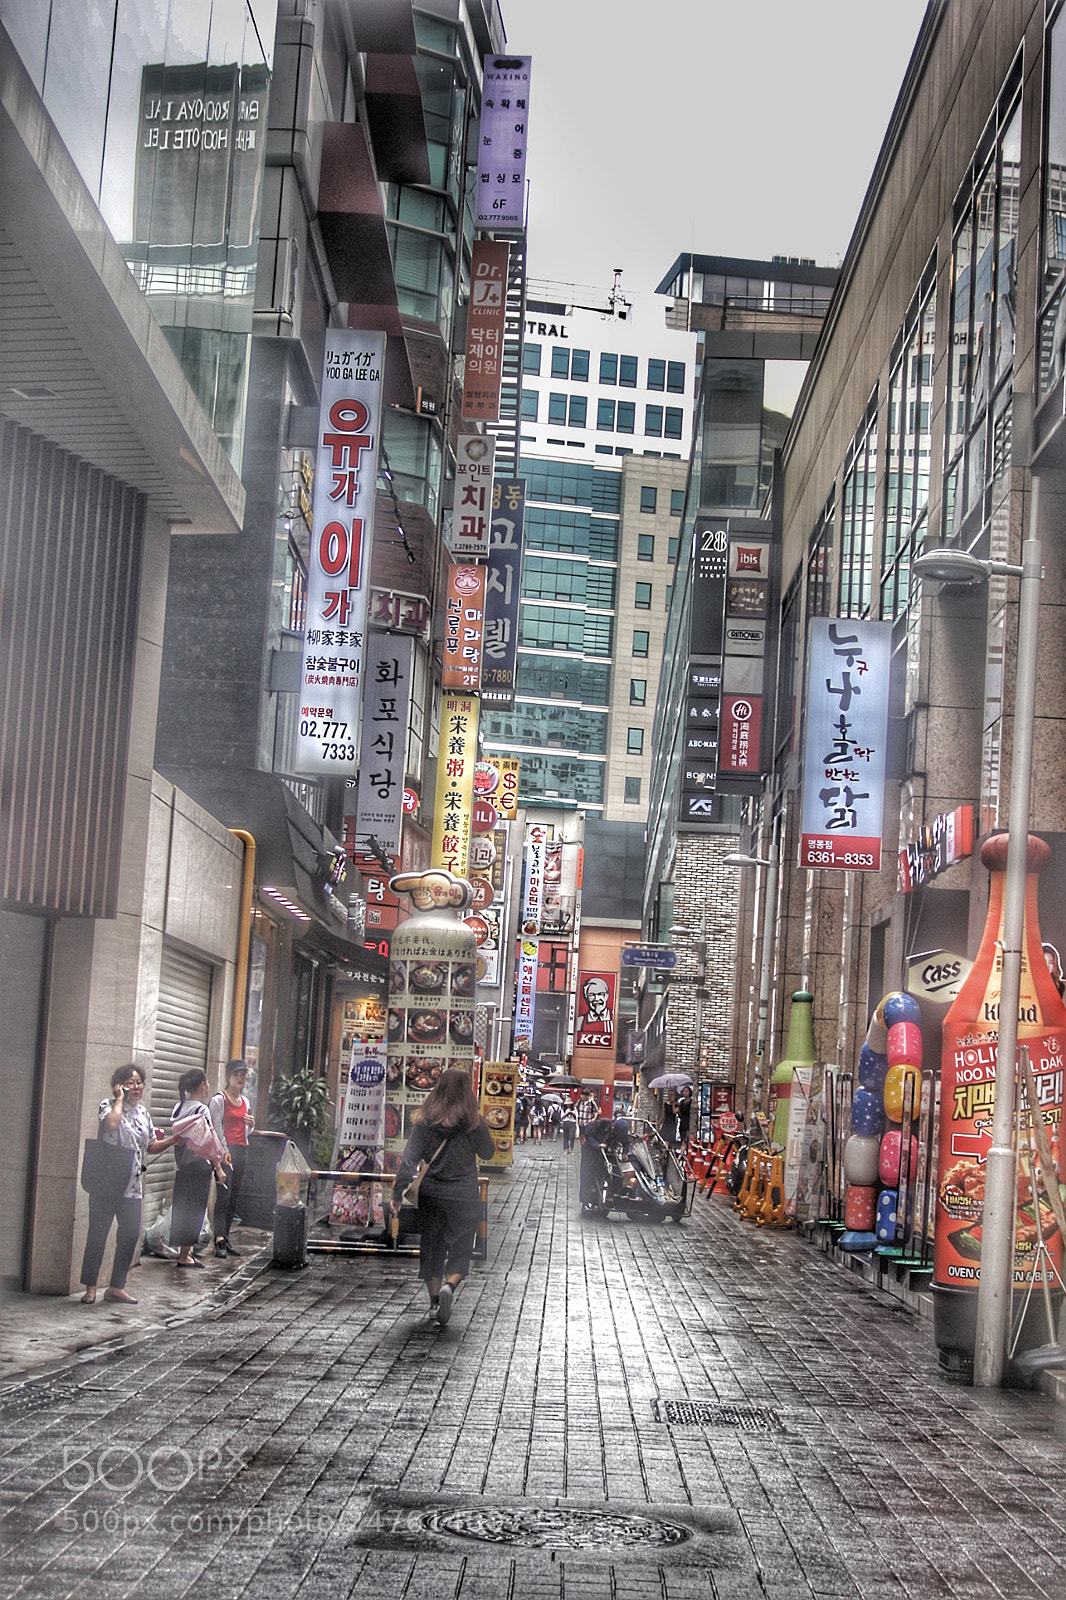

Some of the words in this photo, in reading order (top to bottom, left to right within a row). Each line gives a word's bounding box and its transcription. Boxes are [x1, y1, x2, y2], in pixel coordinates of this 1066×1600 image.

[487, 73, 528, 81] WAXING
[492, 199, 507, 209] 6F
[476, 262, 502, 278] Dr.
[472, 307, 501, 316] CLINIC
[471, 327, 499, 343] 닥터
[326, 350, 376, 367] リュガイガ
[469, 343, 499, 360] 제이
[326, 367, 340, 379] YOO
[342, 368, 353, 380] GA
[355, 369, 368, 381] LEE
[369, 370, 380, 381] GA
[468, 359, 497, 375] 의원
[457, 464, 491, 482] 포인트
[459, 485, 486, 541] 치과
[701, 530, 727, 552] 28
[740, 553, 758, 564] ibis
[369, 595, 431, 632] 치과
[306, 629, 363, 648] 柳家李家
[462, 608, 482, 664] 마라탕
[305, 656, 360, 673] 참숯불구이
[463, 675, 478, 686] 2F
[301, 707, 334, 718] 예약문의
[446, 700, 471, 713] 明洞
[369, 658, 404, 799] 화포식당
[321, 743, 355, 760] 7333
[818, 785, 870, 829] 닭
[808, 840, 834, 850] 명동점
[807, 850, 874, 866] 6361-8353
[579, 1033, 611, 1046] KFC
[956, 1068, 982, 1083] NOO
[1040, 1054, 1063, 1071] DAK
[948, 1266, 974, 1278] OVEN
